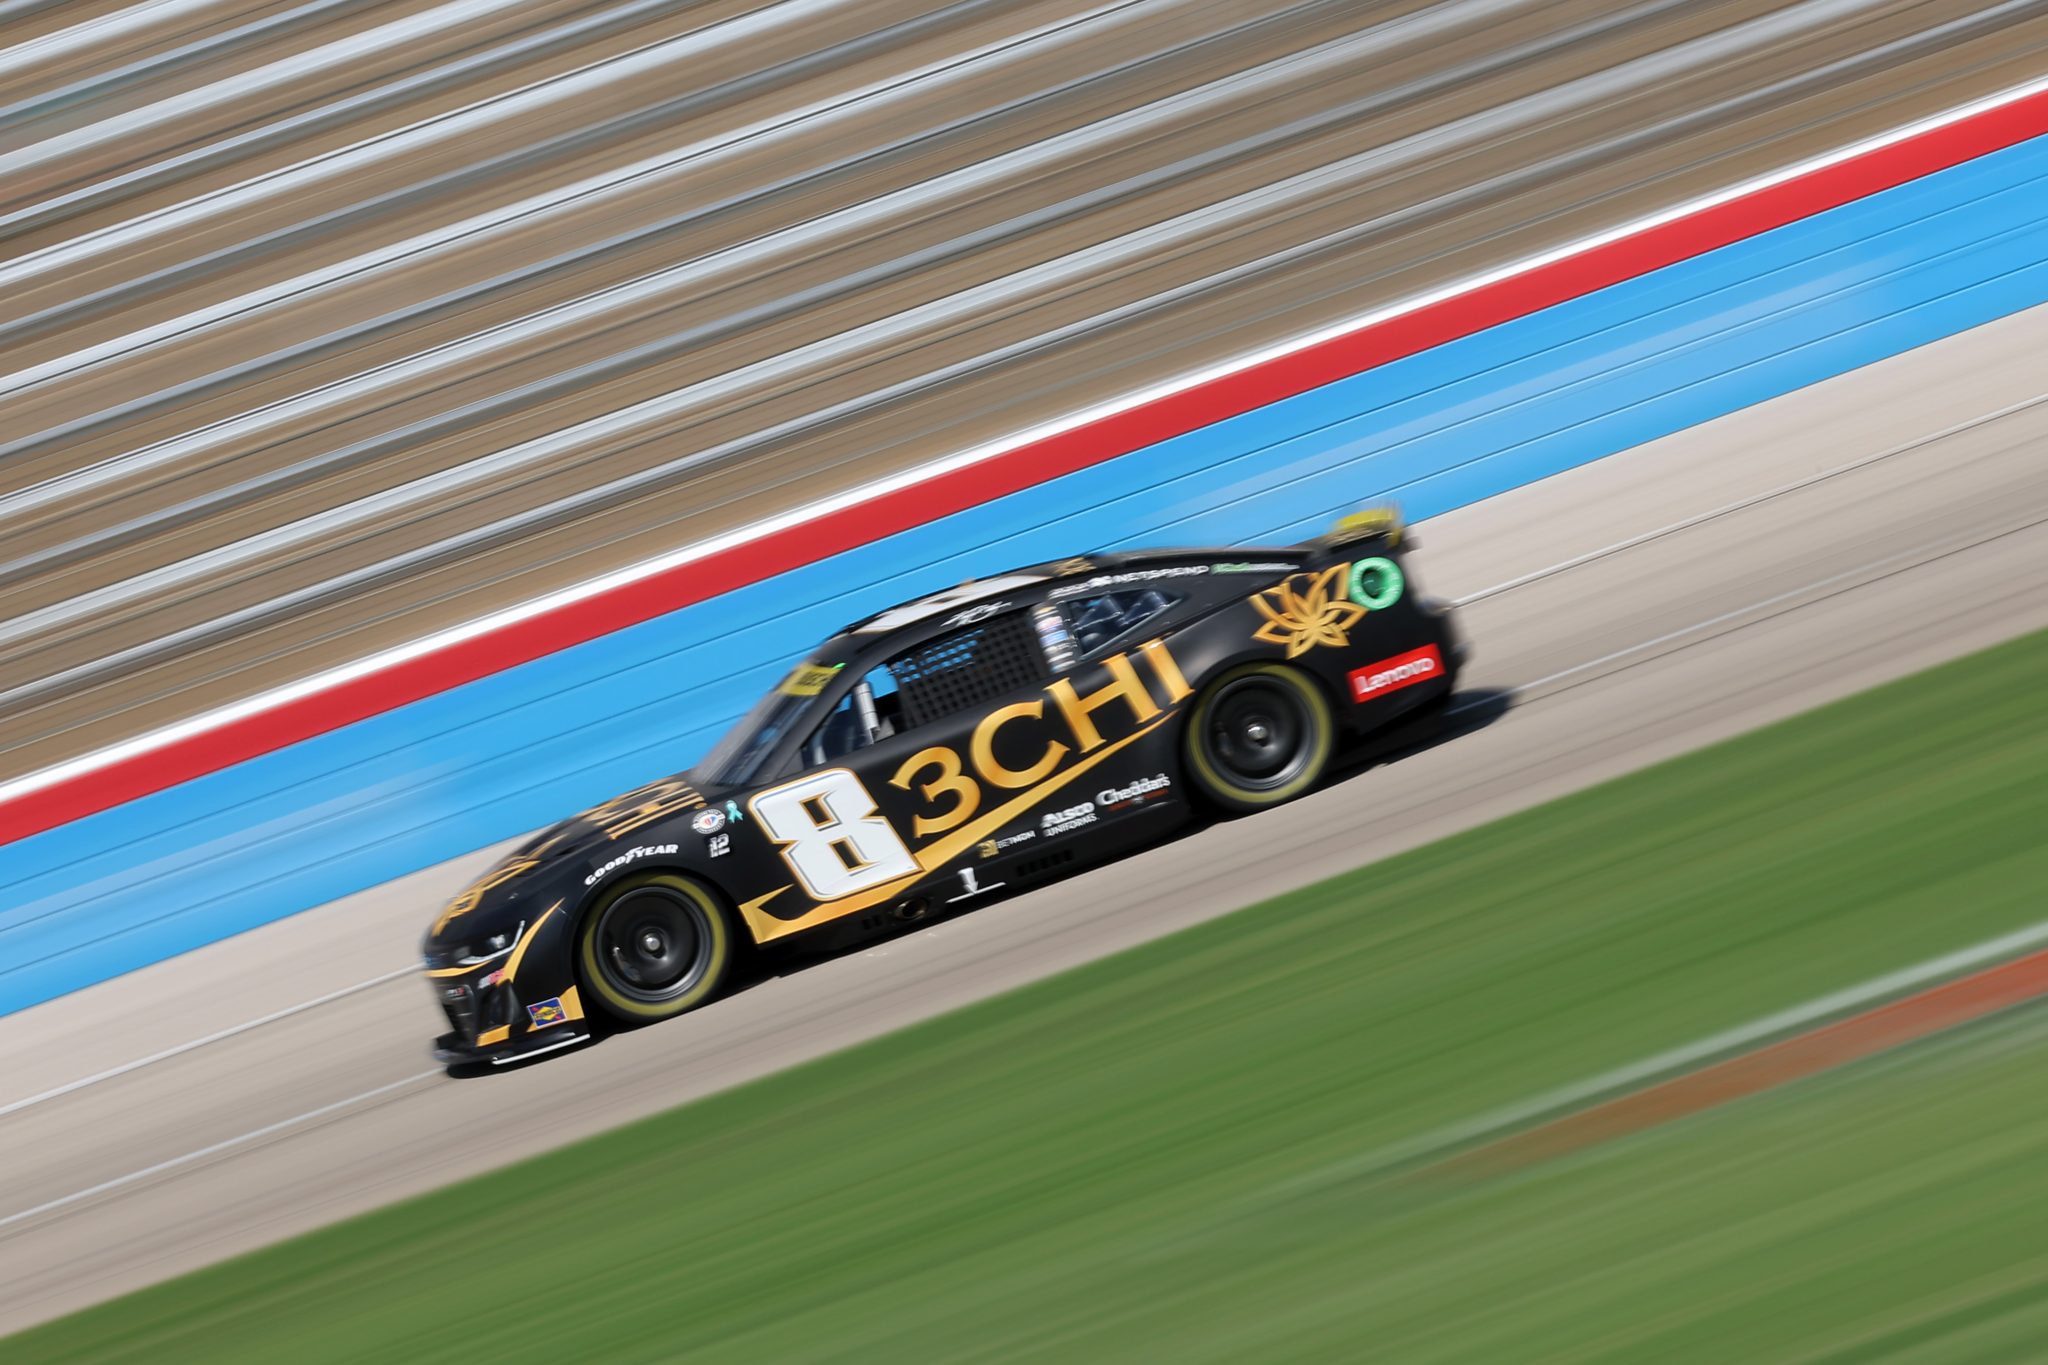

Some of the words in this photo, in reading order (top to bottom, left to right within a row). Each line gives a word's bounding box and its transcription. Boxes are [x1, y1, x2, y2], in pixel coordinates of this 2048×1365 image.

[1353, 656, 1435, 695] Lenovo
[888, 637, 1196, 839] 3CHI
[583, 843, 679, 886] GOODYEAR
[747, 767, 926, 901] 8
